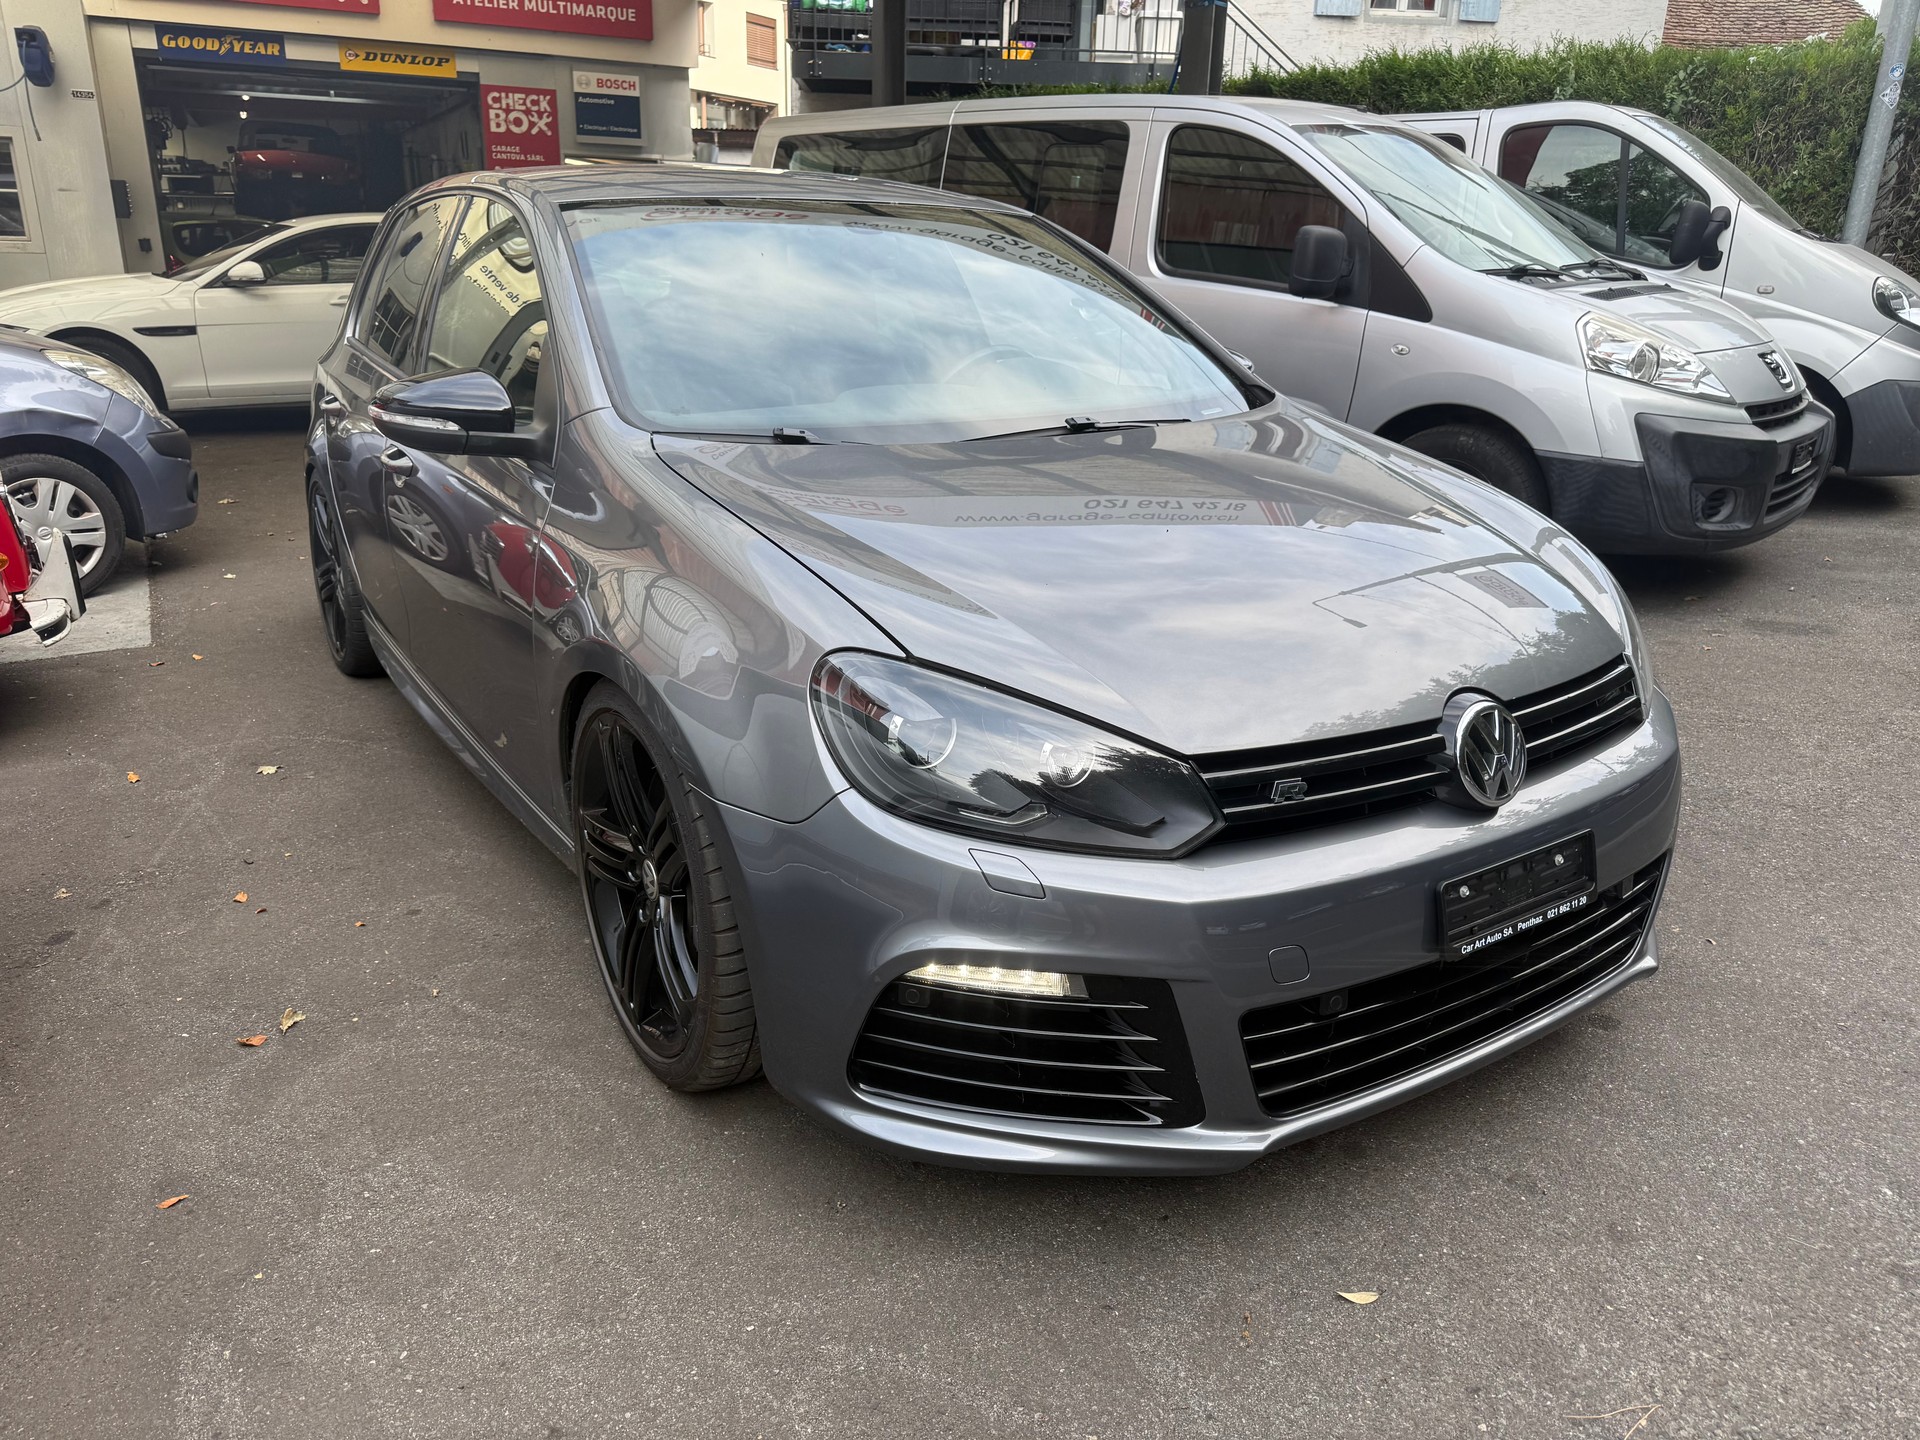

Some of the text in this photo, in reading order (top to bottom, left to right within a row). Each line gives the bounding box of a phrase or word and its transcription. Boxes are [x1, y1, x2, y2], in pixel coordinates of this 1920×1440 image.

[525, 0, 637, 22] MULTIMARQUE
[362, 51, 450, 67] DUNLOP
[596, 78, 636, 91] BOSCH
[487, 91, 551, 112] CHECK
[578, 96, 615, 105] Automotive
[489, 109, 552, 136] BOX
[491, 145, 520, 153] GARAGE
[492, 152, 525, 160] CANTOVA
[1461, 896, 1587, 954] Car Art Auto SA Penthaz 021 862 11 20
